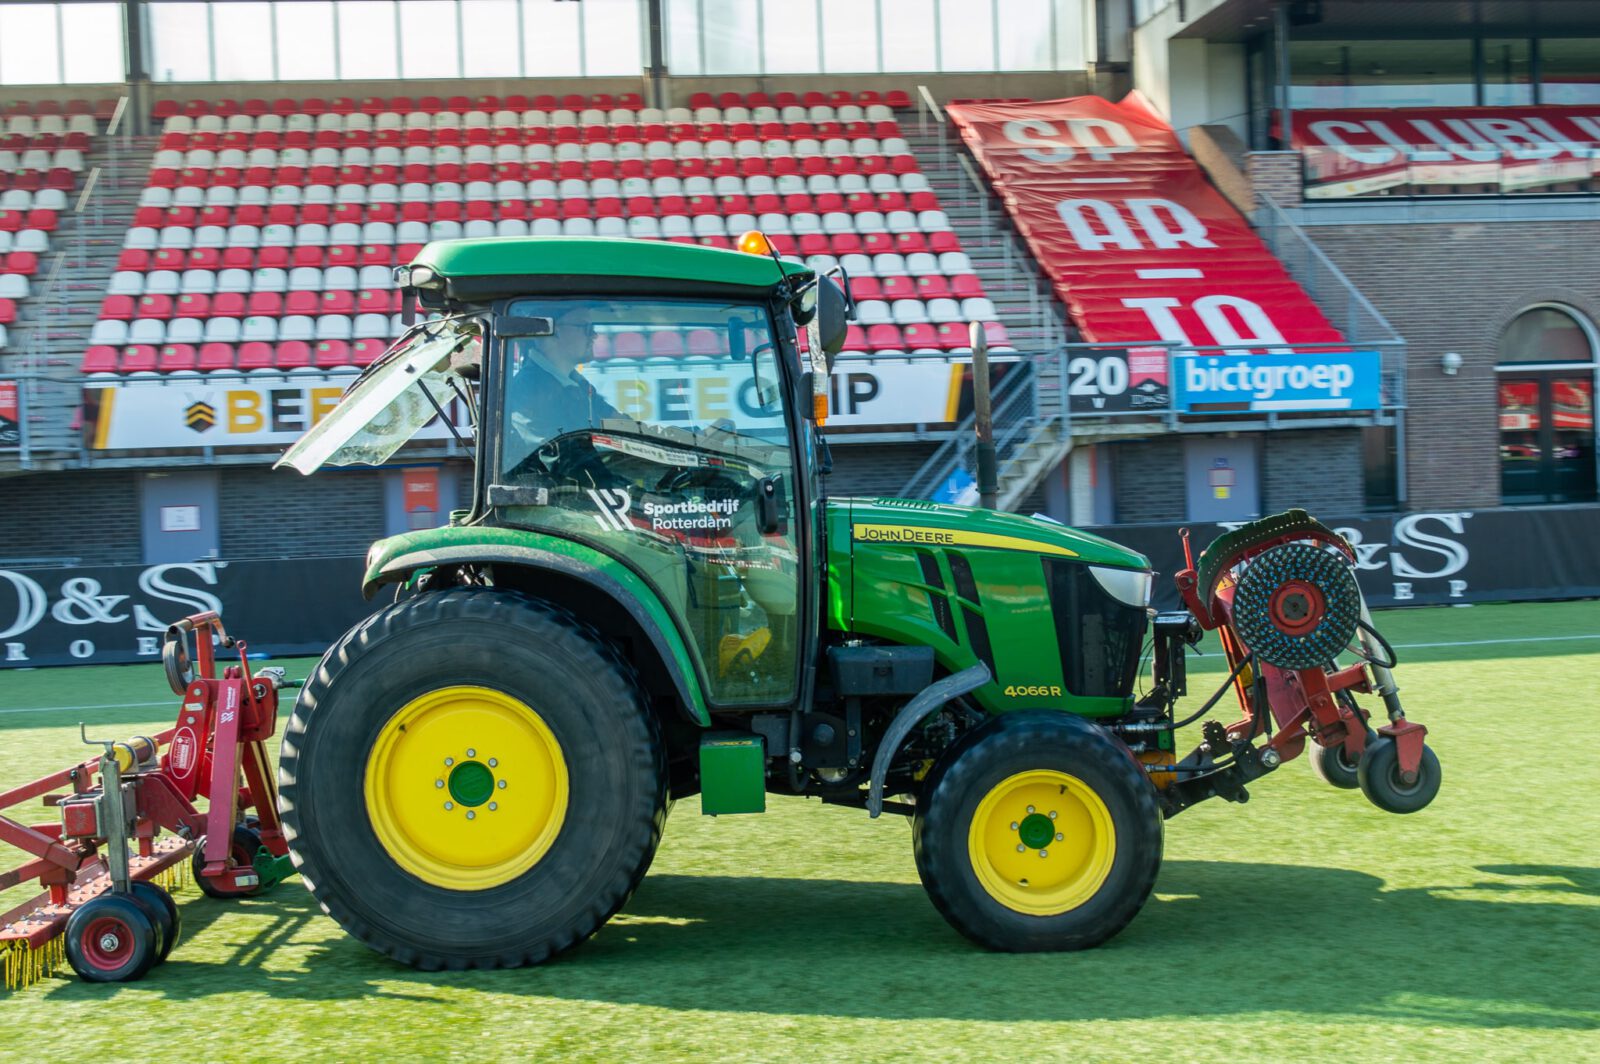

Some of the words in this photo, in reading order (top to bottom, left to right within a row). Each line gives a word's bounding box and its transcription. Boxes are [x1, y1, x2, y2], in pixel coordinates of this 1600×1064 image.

[1003, 118, 1138, 163] SP
[1056, 198, 1219, 250] AR
[1120, 294, 1295, 355] TA
[1068, 356, 1129, 396] 20
[1185, 358, 1354, 399] bictgroep
[643, 499, 740, 517] Sportbedrijf
[652, 516, 731, 531] Rotterdam
[860, 527, 901, 541] JOHN
[903, 528, 954, 543] DEERE
[1003, 685, 1062, 698] 4066R
